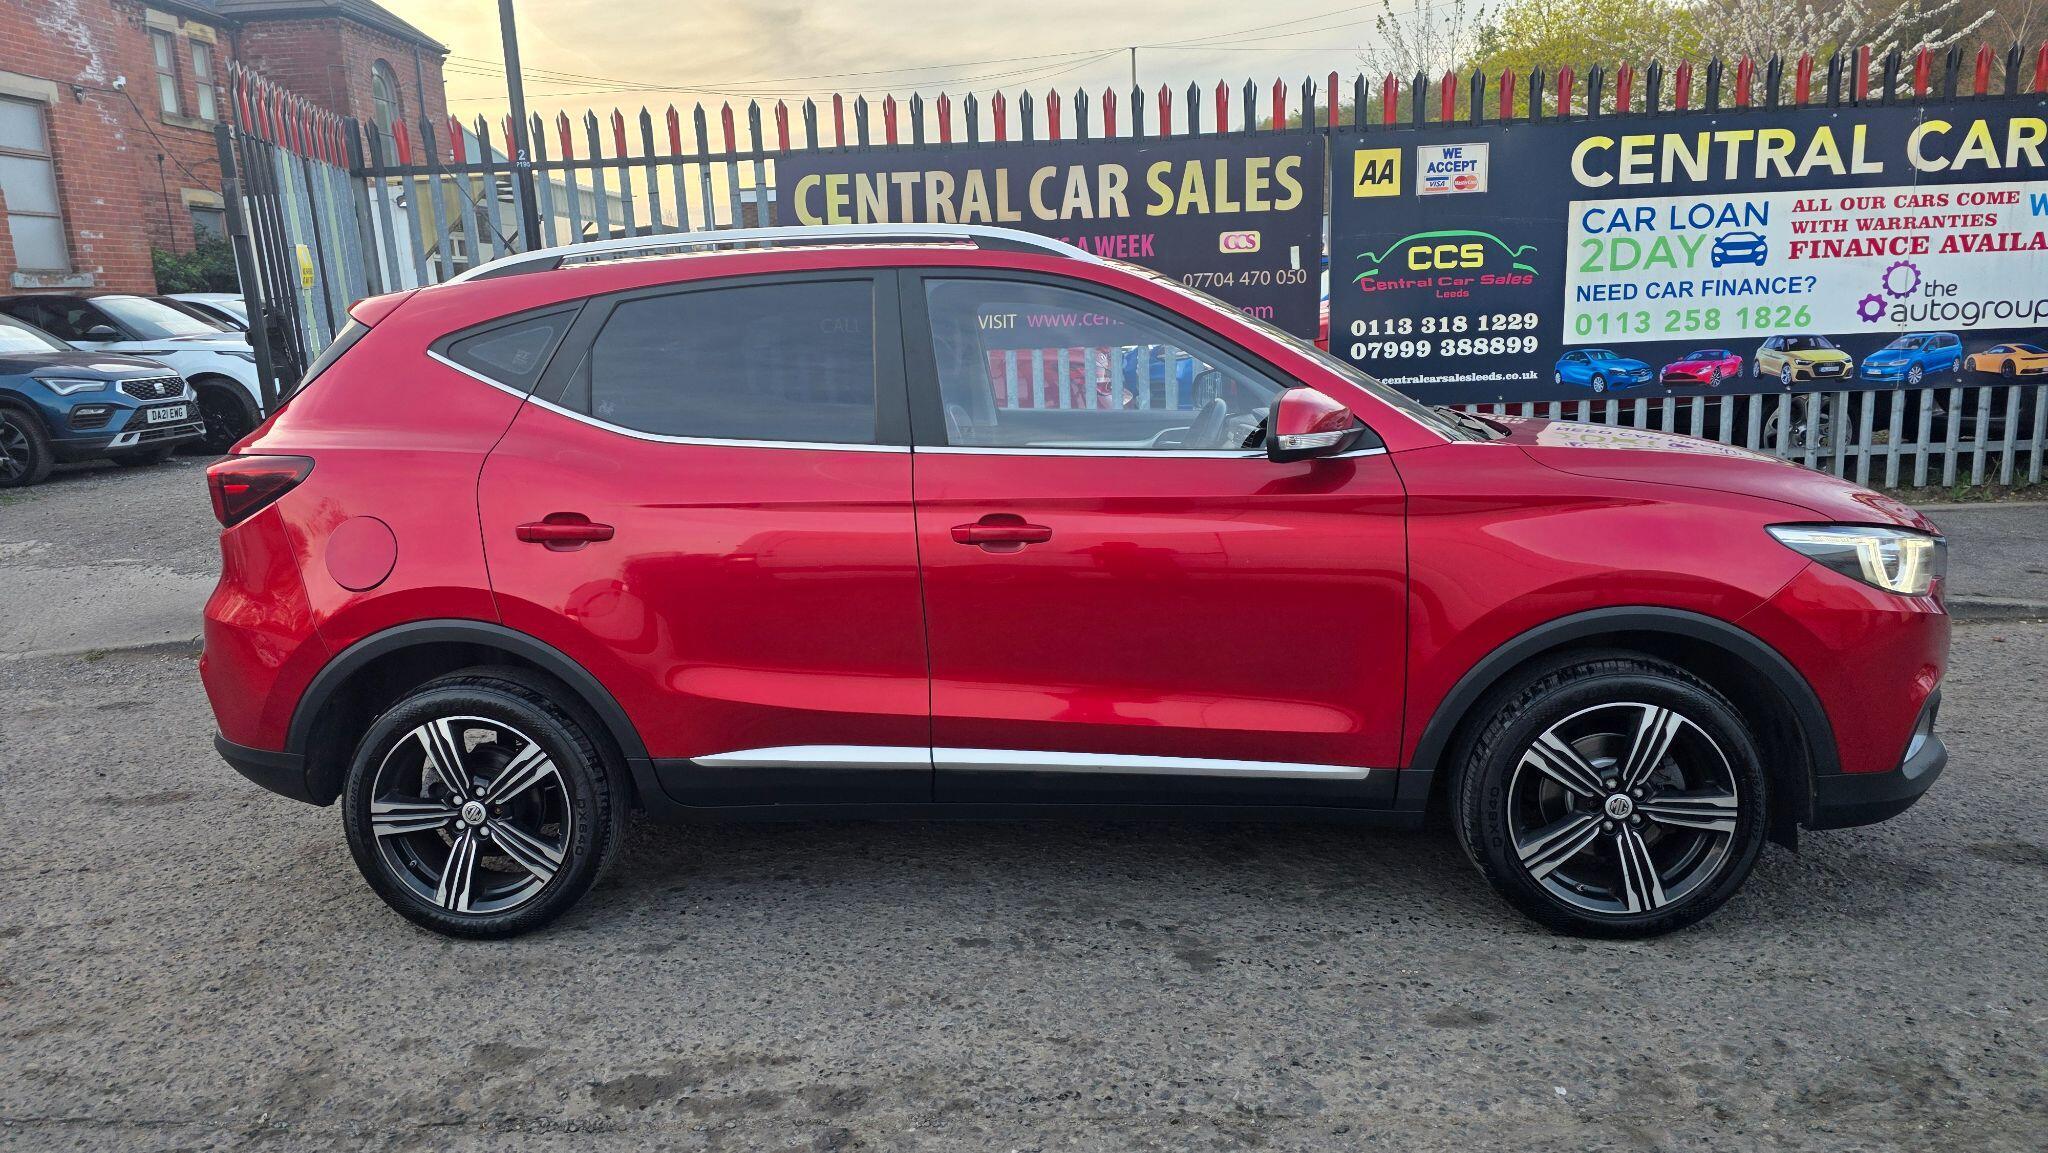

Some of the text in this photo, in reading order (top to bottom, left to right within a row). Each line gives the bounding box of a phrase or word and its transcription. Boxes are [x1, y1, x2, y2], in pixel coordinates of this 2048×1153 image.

[518, 149, 526, 161] 2
[1442, 147, 1463, 160] WE
[1571, 117, 2048, 187] CENTRAL CAR
[1359, 159, 1394, 185] AA
[1427, 160, 1478, 174] ACCEPT
[794, 155, 1304, 225] CENTRAL CAR SALES
[1792, 191, 2021, 213] ALL OUR CARS COME
[1582, 201, 1769, 234] CAR LOAN
[1791, 213, 1998, 234] WITH WARRANTIES
[1094, 233, 1155, 258] WEEK
[1408, 243, 1484, 271] CCS
[1579, 233, 1707, 273] 2DAY
[1788, 235, 1930, 260] FINANCE
[1183, 268, 1307, 288] 07704 470 050
[1360, 273, 1533, 292] Central Car Sales
[1576, 275, 1817, 303] NEED CAR FINANCE?
[1924, 280, 1958, 297] the
[1435, 289, 1470, 299] Leeds
[978, 313, 1018, 329] VISIT
[1350, 312, 1539, 337] 0113 318 1229
[1575, 304, 1812, 336] 0113 258 1826
[1350, 335, 1539, 360] 07999 388899
[152, 409, 169, 421] DA21
